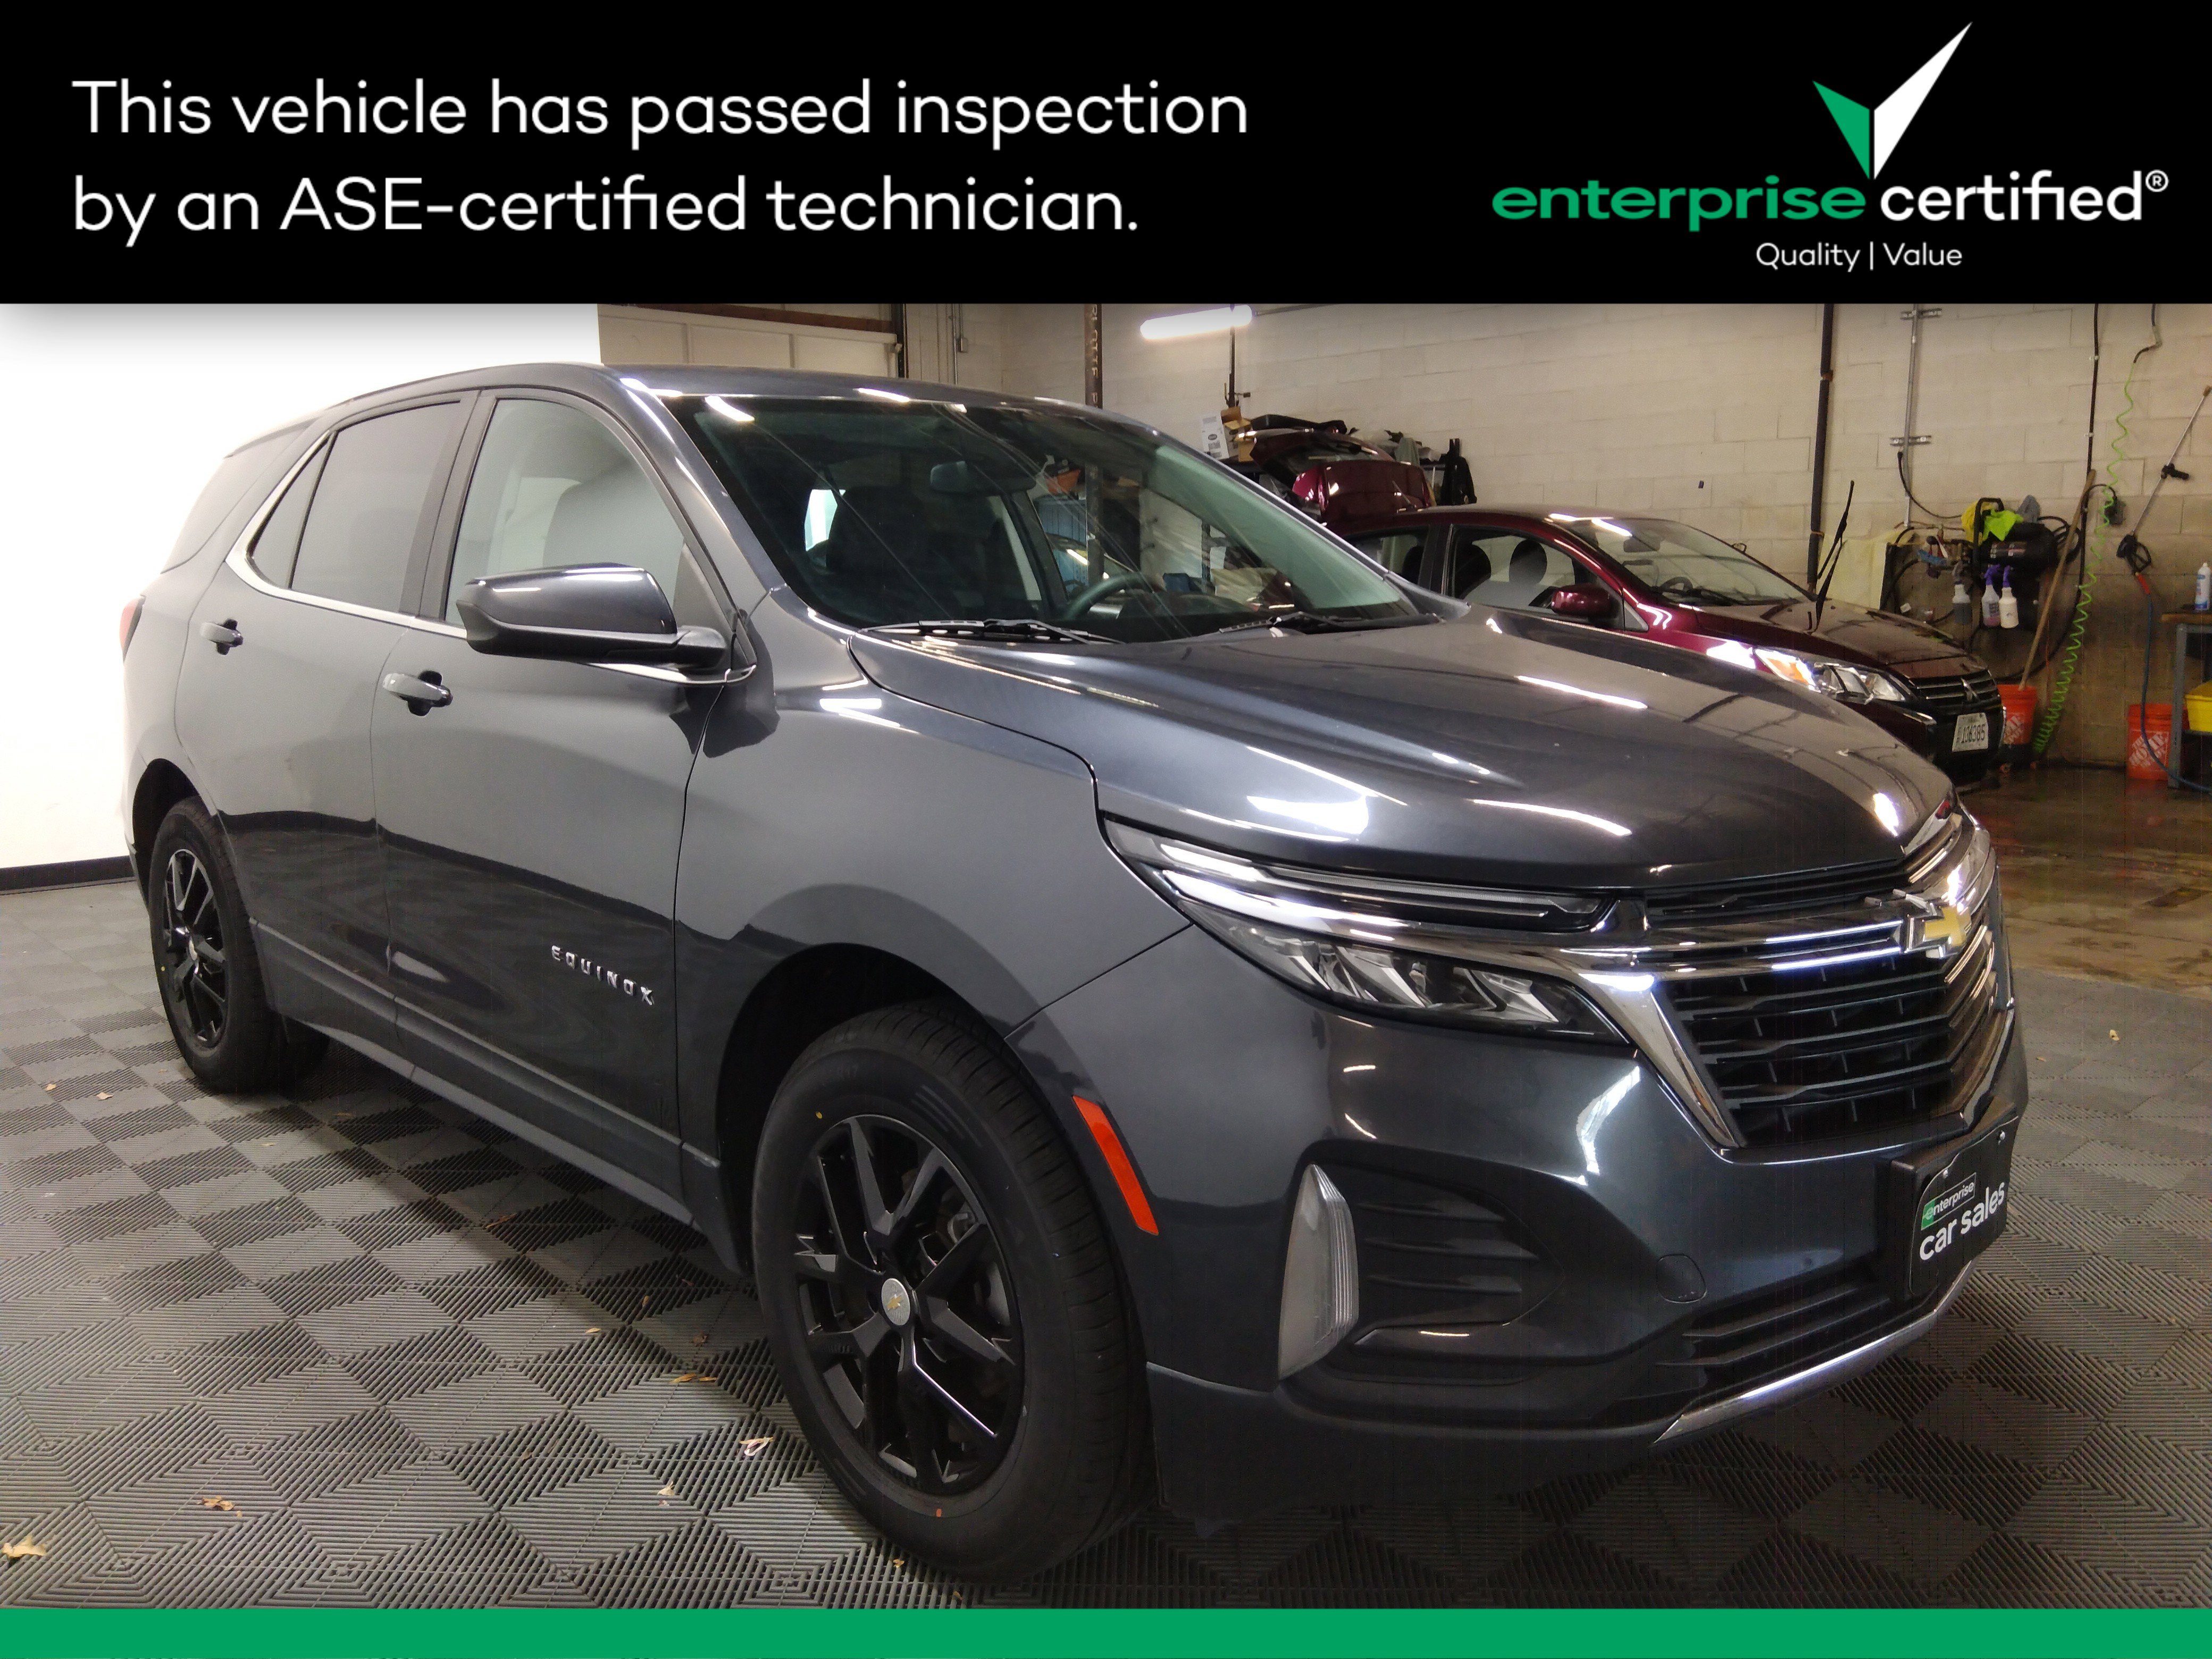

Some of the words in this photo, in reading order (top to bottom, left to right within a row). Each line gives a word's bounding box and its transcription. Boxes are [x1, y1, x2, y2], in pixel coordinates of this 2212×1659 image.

[551, 945, 654, 1006] EQUINOX
[1920, 1219, 1957, 1260] car
[1960, 1182, 2005, 1235] sales
[1922, 1182, 1974, 1220] enterprise
